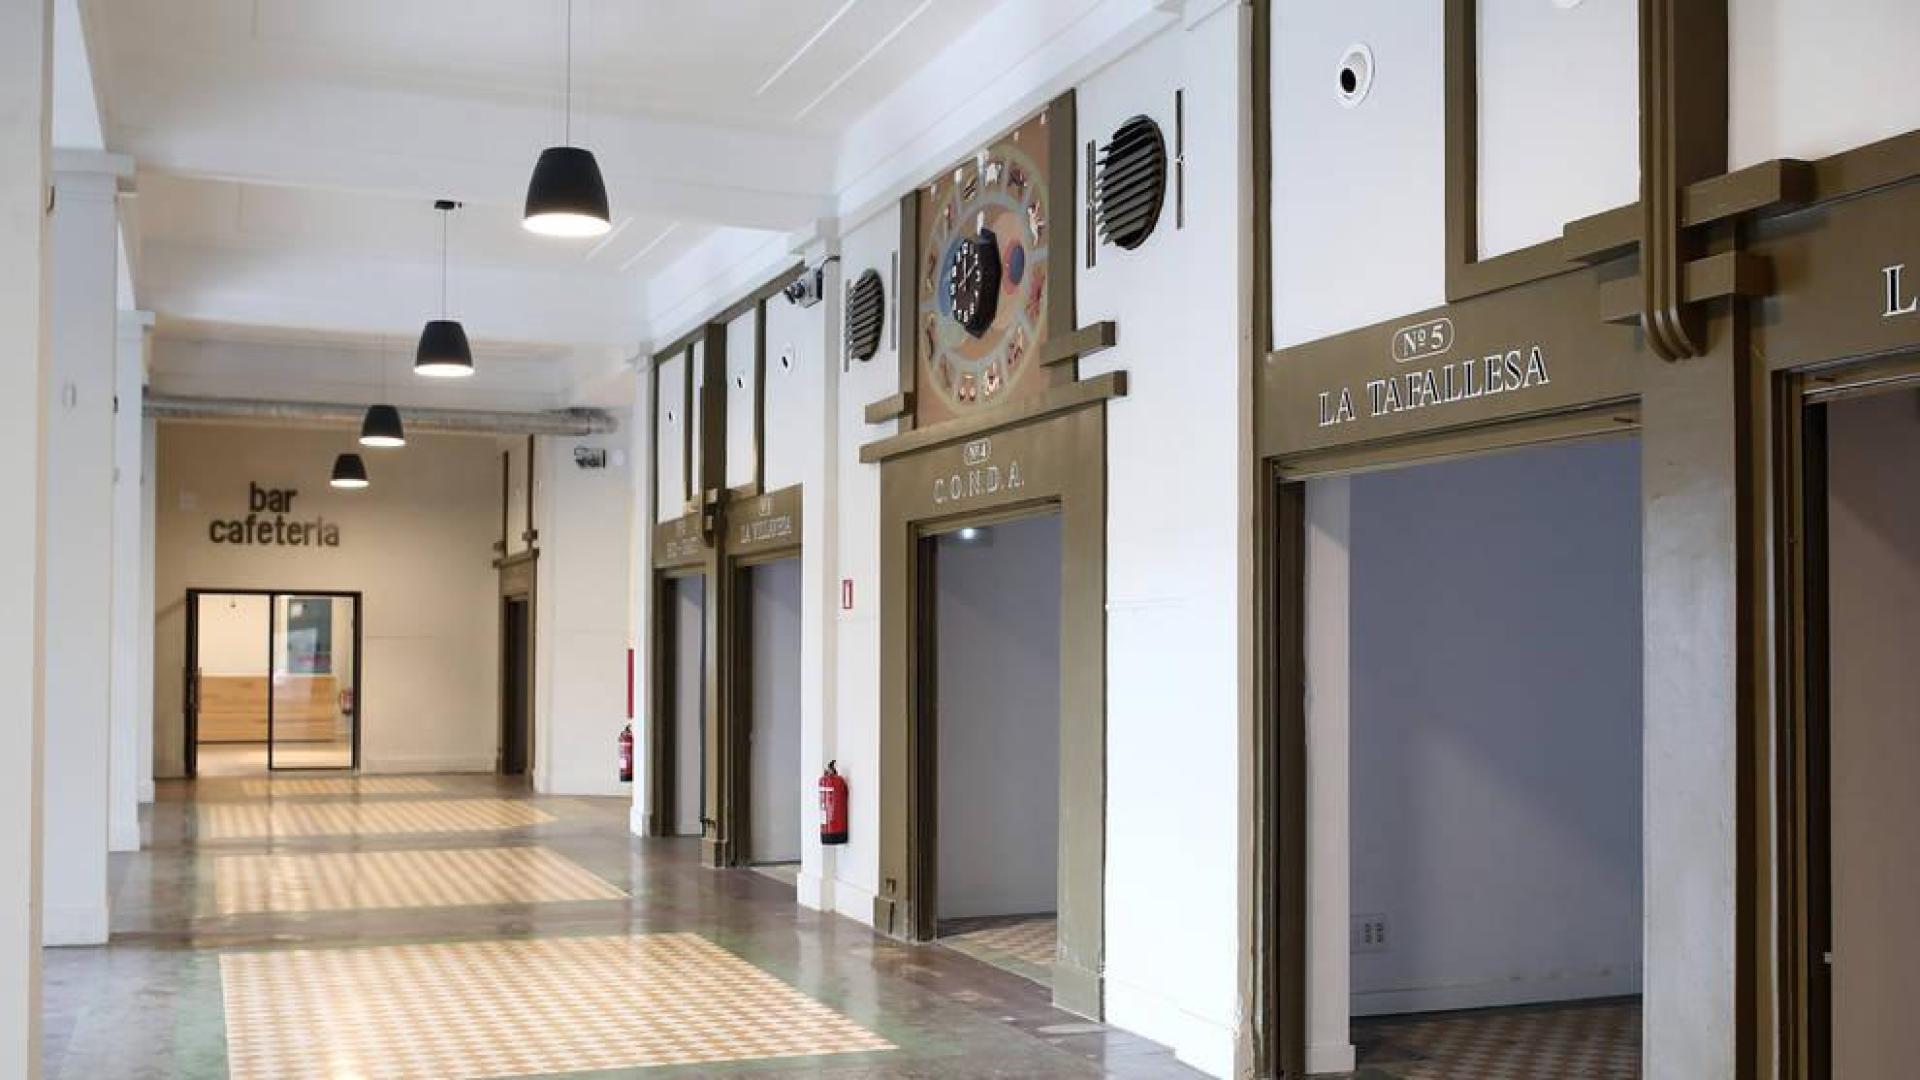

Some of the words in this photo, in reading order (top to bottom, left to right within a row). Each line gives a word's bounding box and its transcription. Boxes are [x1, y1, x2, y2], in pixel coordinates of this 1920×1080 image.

[1430, 325, 1445, 350] 5
[1318, 387, 1356, 428] LA
[1366, 345, 1551, 418] TAFALLESA
[249, 481, 298, 513] bar
[208, 515, 341, 548] cafeteria
